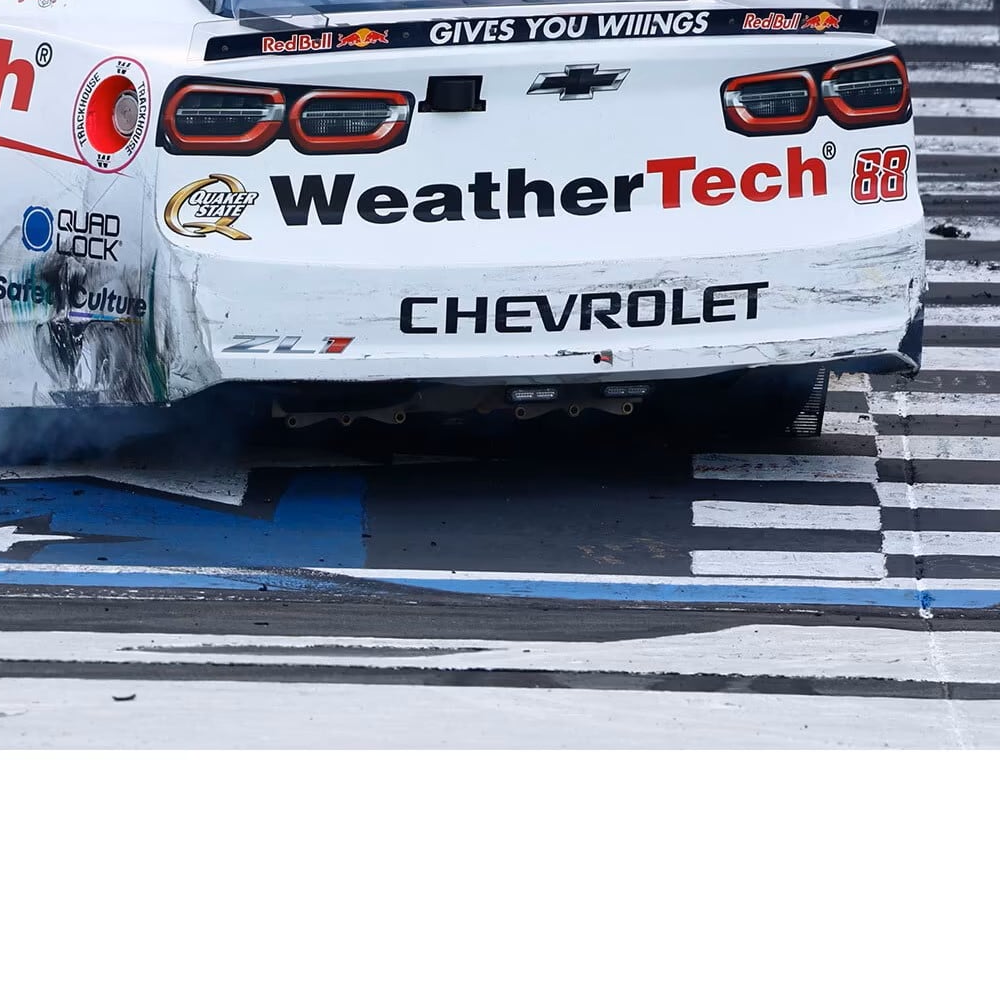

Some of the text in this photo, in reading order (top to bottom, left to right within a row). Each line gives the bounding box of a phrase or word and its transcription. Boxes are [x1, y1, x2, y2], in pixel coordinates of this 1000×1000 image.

[429, 11, 711, 46] GIVES YOU WIIINGS
[76, 71, 101, 148] TRACKHOUSE
[124, 80, 147, 157] TRACKHOUSE
[851, 144, 910, 205] 88
[187, 189, 259, 206] QUAKER
[194, 204, 247, 218] STATE
[57, 208, 120, 238] QUAD
[55, 232, 119, 262] LOCK
[399, 281, 769, 335] CHEVROLET
[221, 335, 356, 355] ZL1
